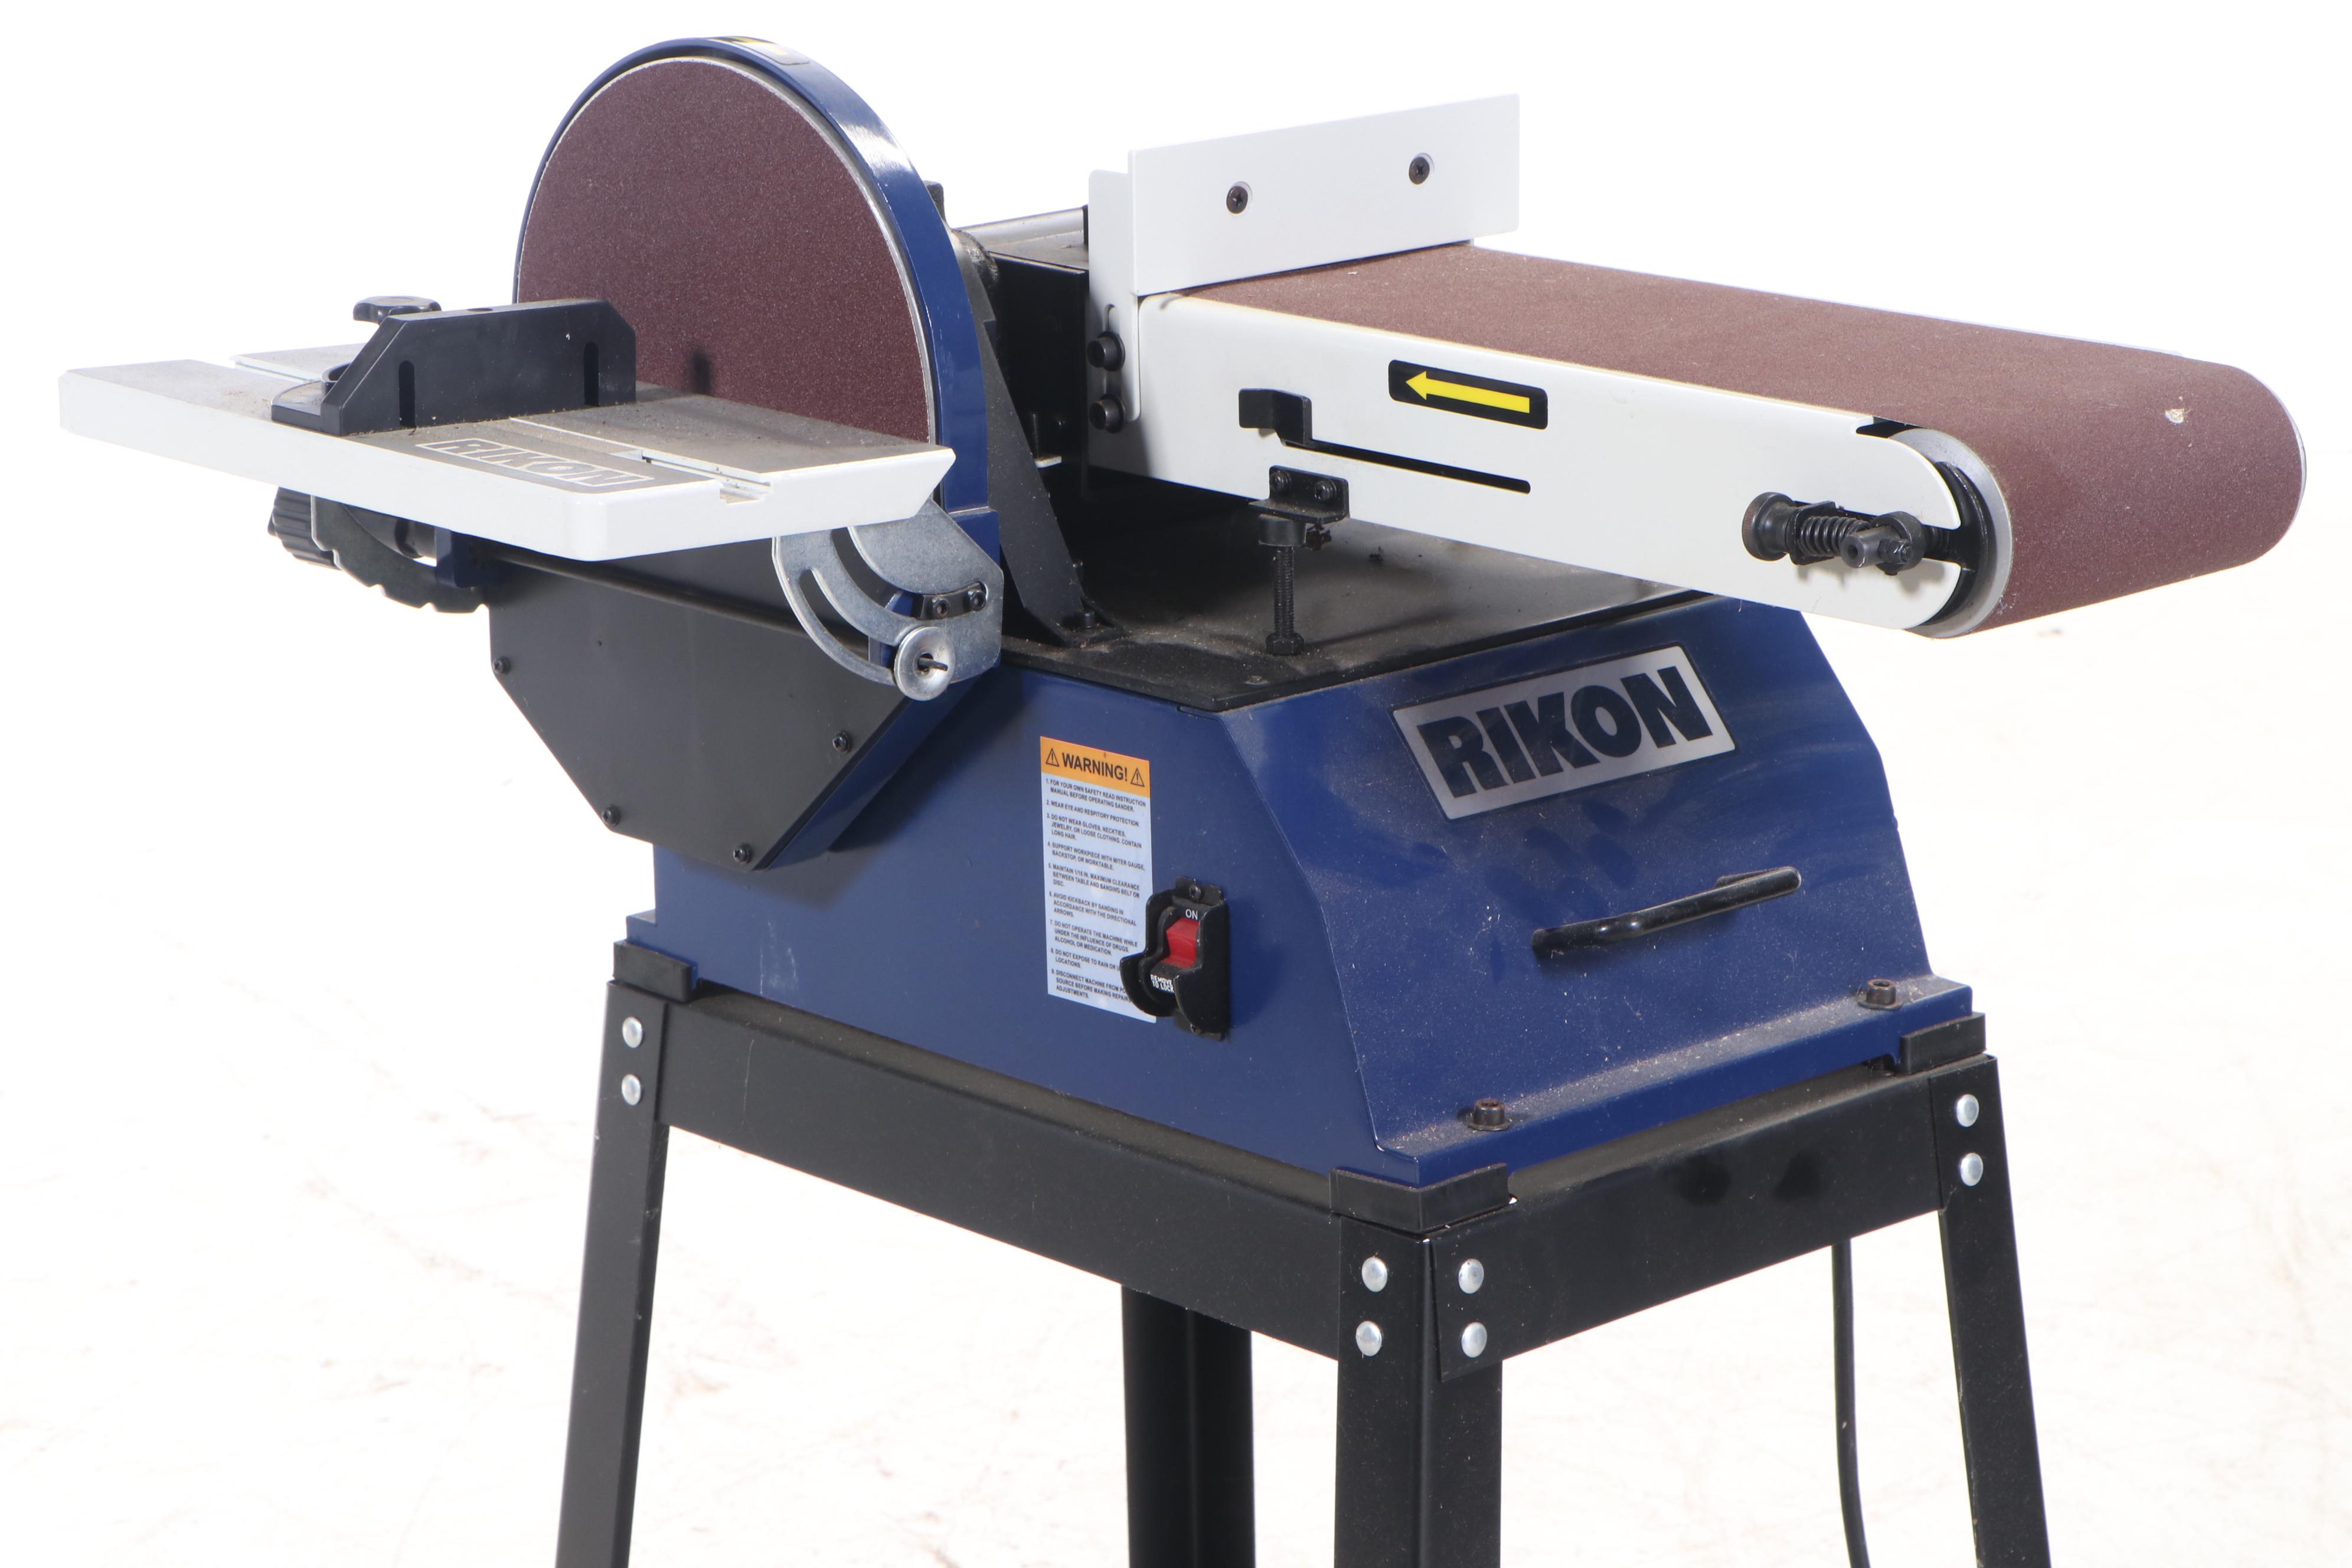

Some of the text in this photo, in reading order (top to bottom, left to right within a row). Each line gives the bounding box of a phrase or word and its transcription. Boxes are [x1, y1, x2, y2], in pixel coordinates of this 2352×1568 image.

[1417, 666, 1713, 798] RIKON
[1062, 752, 1127, 782] WARNING!
[1050, 787, 1133, 812] MANUAL BEFORE OPERATING SANDER.
[1061, 782, 1072, 790] YOUR
[1084, 788, 1101, 796] SAFETY
[1103, 792, 1115, 800] READ
[1116, 795, 1146, 807] INSTRUCTION
[1051, 801, 1063, 809] WEAR
[1084, 808, 1109, 819] RESPITORY
[1110, 815, 1139, 827] PROTECTION.
[1081, 829, 1096, 838] LOOSE
[1122, 838, 1141, 848] CONTAIN
[1052, 842, 1073, 852] SUPPORT
[1074, 847, 1100, 859] WORKPIECE
[1113, 857, 1126, 865] MITER
[1085, 858, 1114, 870] WORKTABLE.
[1053, 864, 1073, 874] MAINTAIN
[1090, 873, 1111, 884] MAXIMUM
[1112, 878, 1139, 891] CLEARANCE
[1053, 871, 1074, 882] BETWEEN
[1075, 877, 1089, 886] TABLE
[1100, 883, 1120, 893] SANDING
[1054, 892, 1067, 900] AVOID
[1068, 896, 1090, 907] KICKBACK
[1099, 904, 1118, 914] SANDING
[1054, 900, 1084, 913] ACCORDANCE
[1107, 913, 1136, 926] DIRECTIONAL
[1185, 909, 1198, 920] ON
[1055, 928, 1070, 937] UNDER
[1080, 935, 1105, 946] INFLUENCE
[1055, 936, 1075, 946] ALCOHOL
[1072, 925, 1092, 935] OPERATE
[1103, 933, 1122, 943] MACHINE
[1123, 938, 1137, 947] WHILE
[1073, 953, 1090, 963] EXPOSE
[1056, 969, 1083, 982] DISCONNECT
[1086, 978, 1105, 988] MACHINE
[1106, 983, 1119, 991] FROM
[1056, 977, 1074, 987] SOURCE
[1075, 982, 1093, 992] BEFORE
[1094, 988, 1111, 997] MAKING
[1150, 974, 1172, 985] REMOVE
[1160, 983, 1174, 993] LOCK
